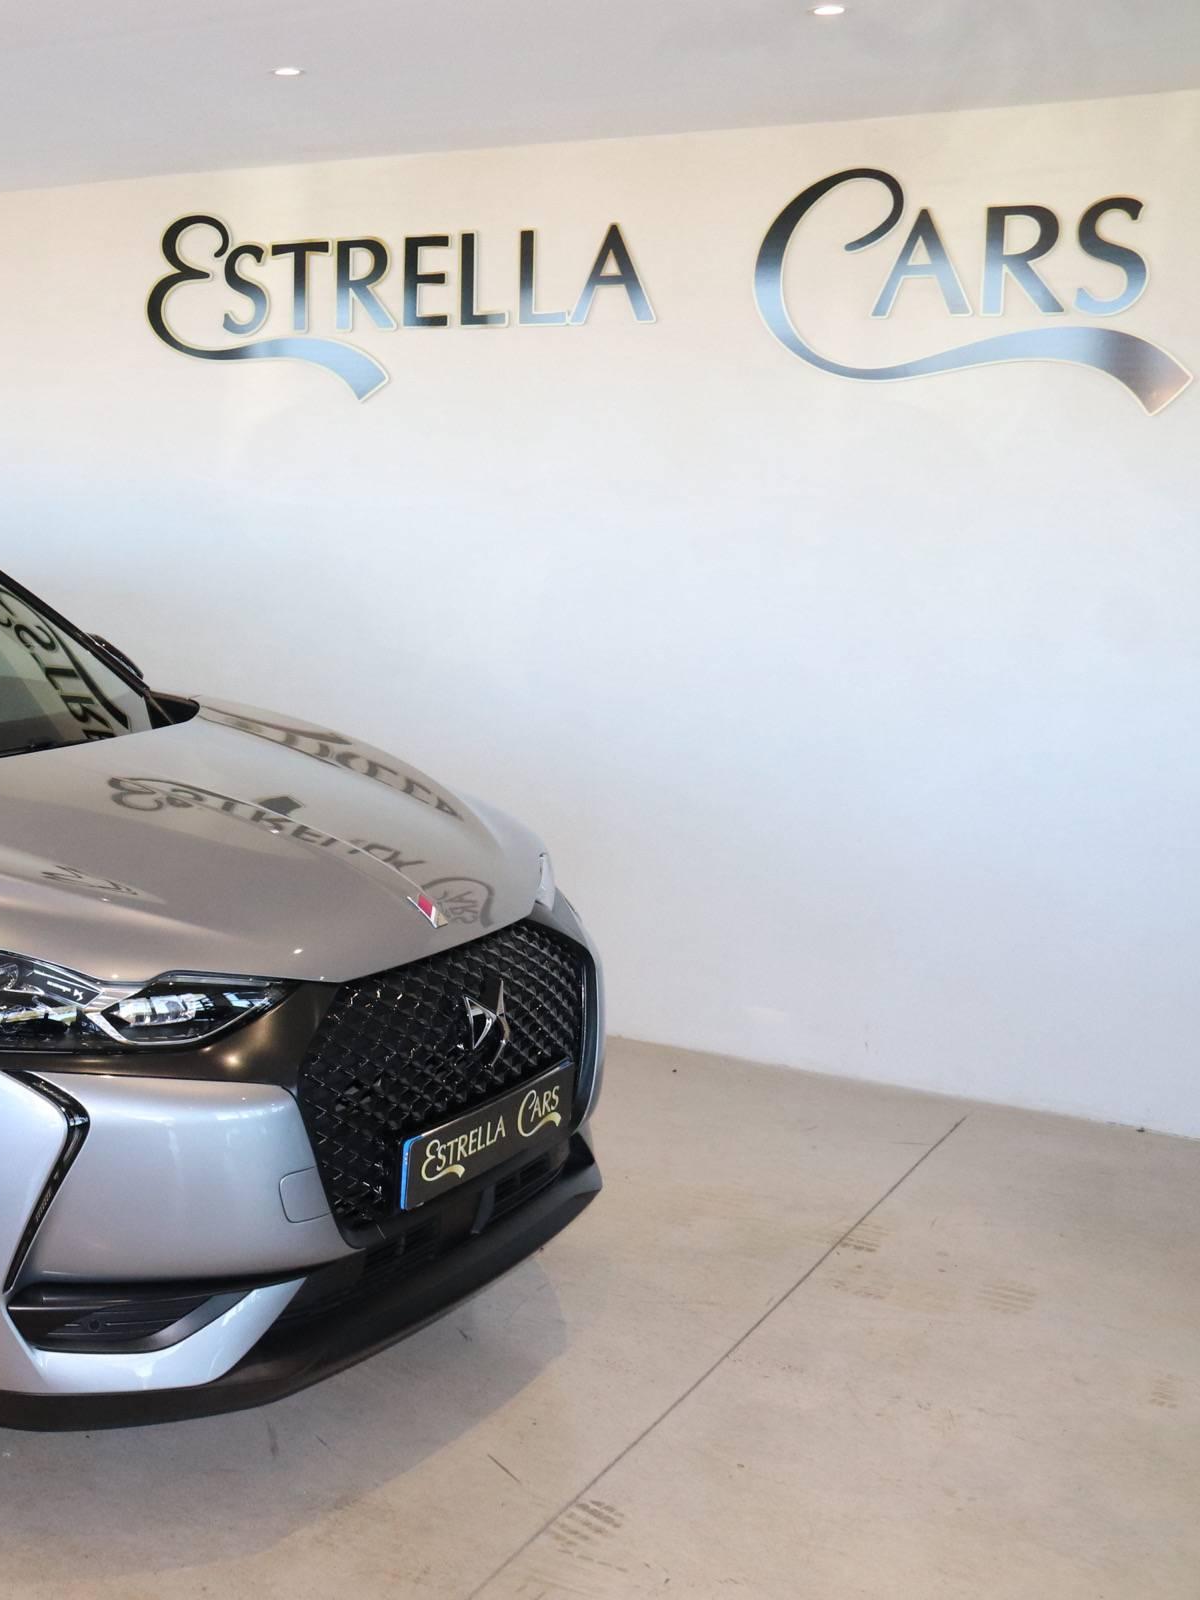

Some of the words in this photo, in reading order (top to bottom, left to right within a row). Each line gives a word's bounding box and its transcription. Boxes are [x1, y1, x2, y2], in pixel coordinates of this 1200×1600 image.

[145, 213, 656, 402] ESTRELLA
[752, 167, 1193, 416] CARS
[421, 1115, 506, 1181] ESTRELLA
[517, 1086, 562, 1137] CARS
